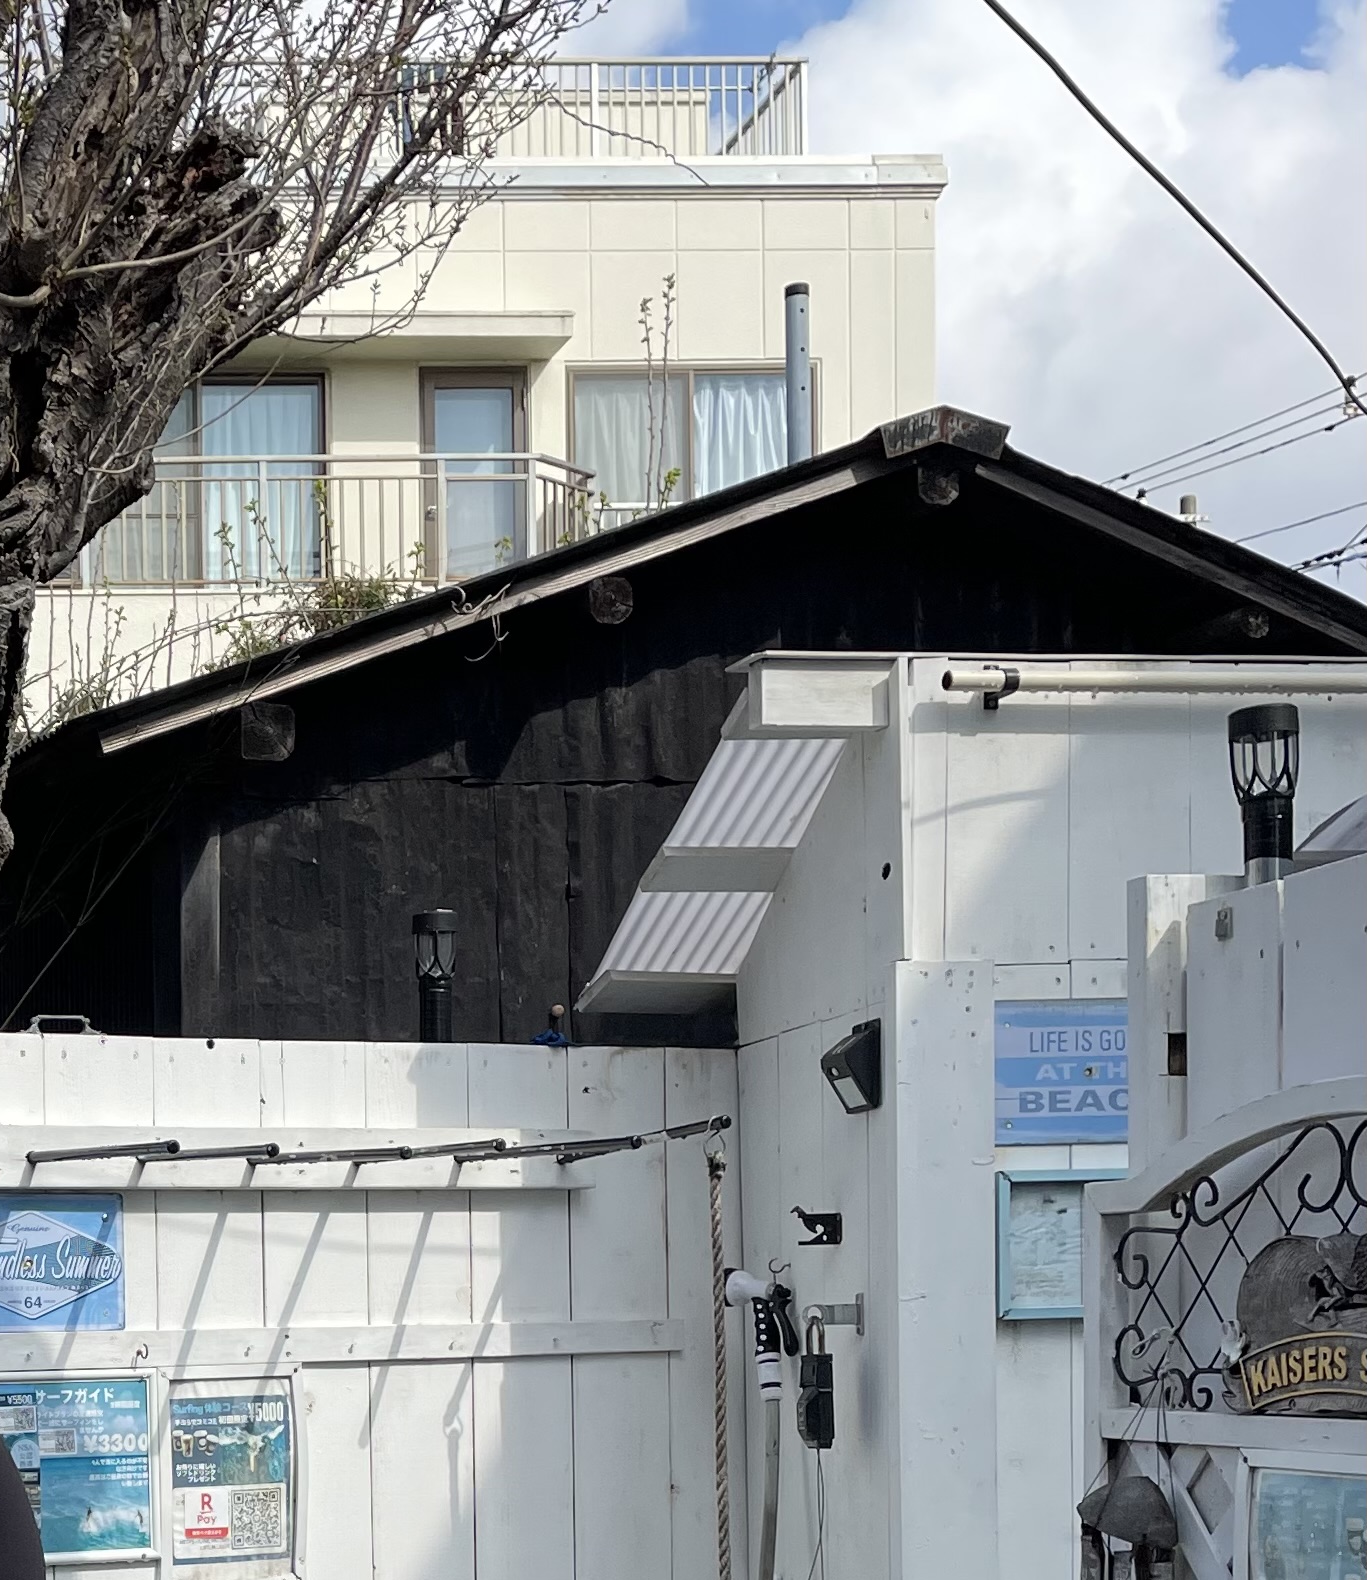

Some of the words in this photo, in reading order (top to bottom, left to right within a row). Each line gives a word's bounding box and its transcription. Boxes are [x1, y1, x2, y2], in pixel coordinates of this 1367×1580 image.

[1029, 1031, 1069, 1053] LIFE
[1075, 1029, 1093, 1052] IS
[1035, 1062, 1078, 1081] AT
[51, 1233, 122, 1281] Summer
[23, 1296, 43, 1309] 64
[1250, 1346, 1348, 1397] KAISERS
[35, 1387, 115, 1405] サーフガイド
[172, 1403, 204, 1415] Surfing
[248, 1400, 284, 1423] ¥5000
[83, 1433, 148, 1454] ¥3300
[196, 1514, 217, 1526] Pay
